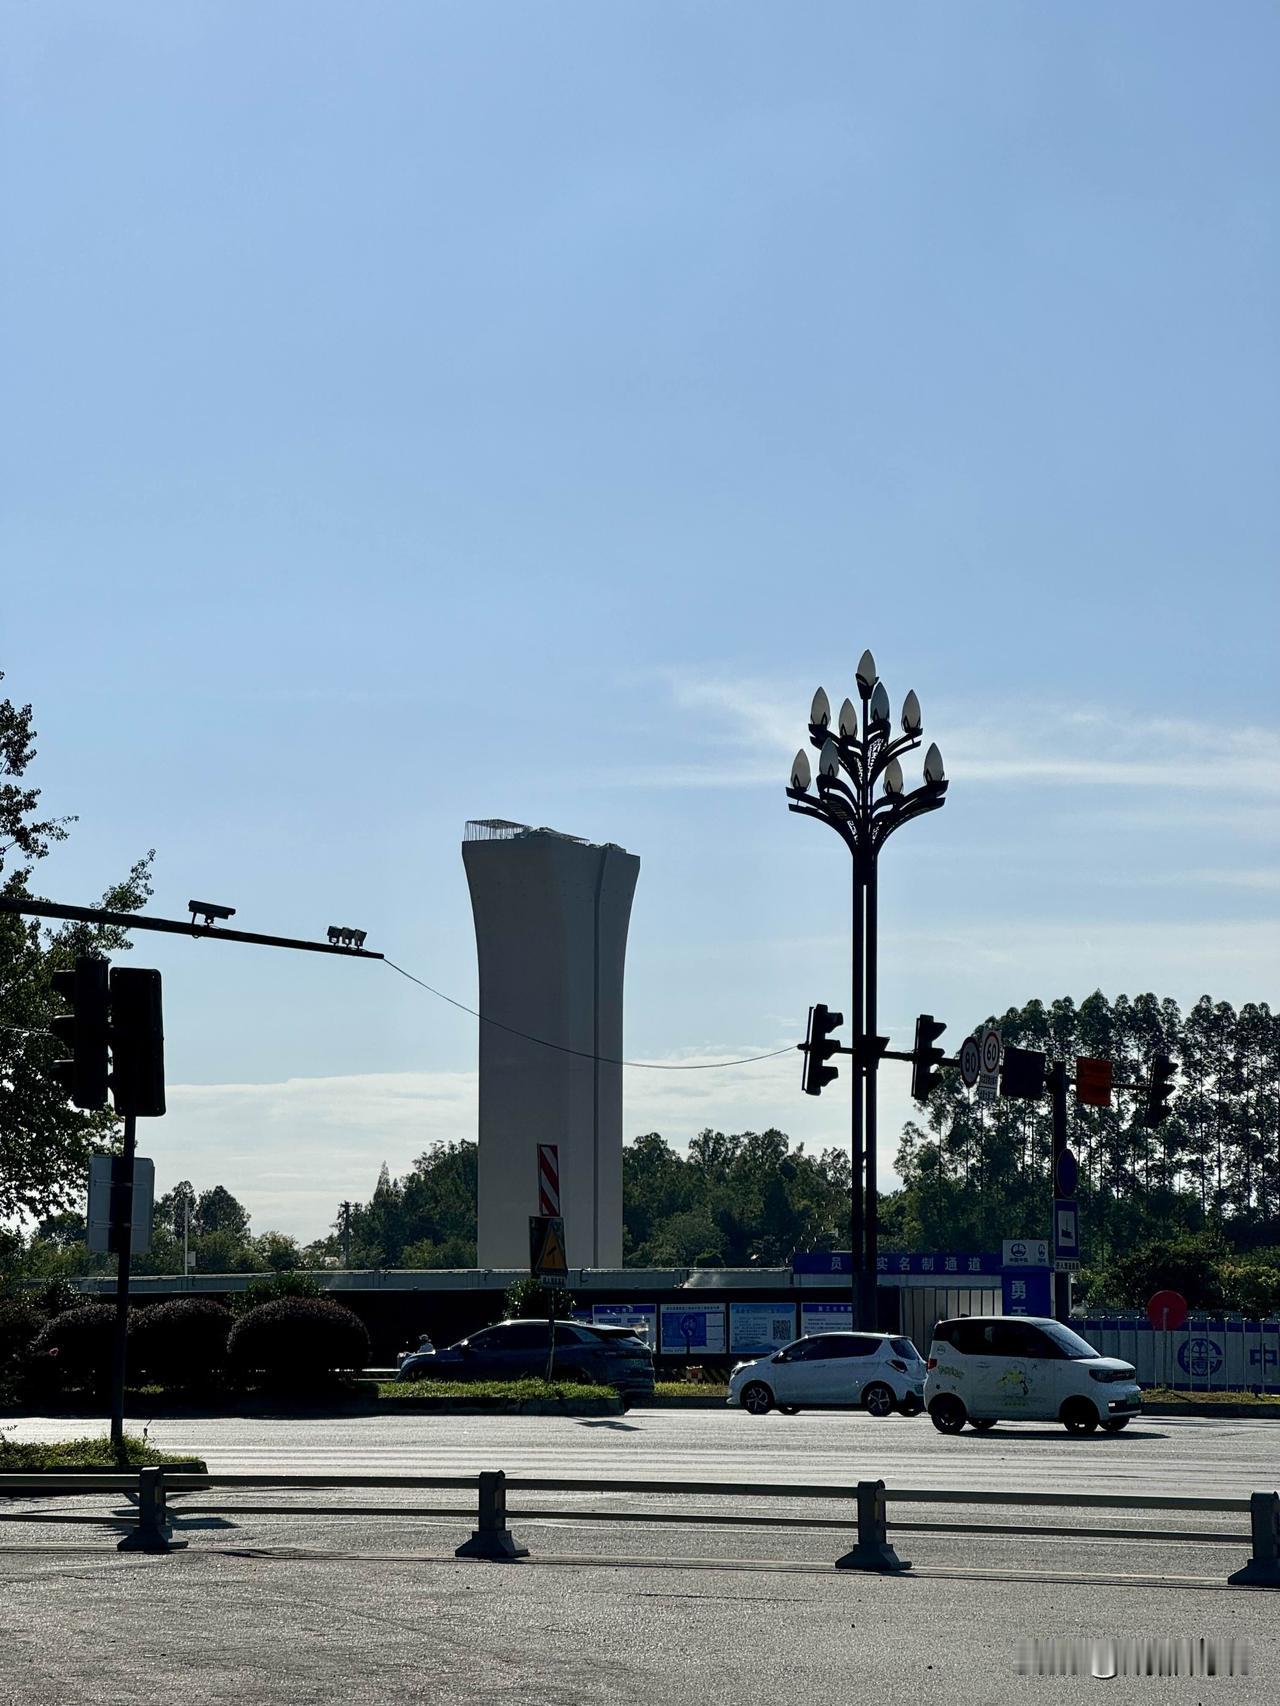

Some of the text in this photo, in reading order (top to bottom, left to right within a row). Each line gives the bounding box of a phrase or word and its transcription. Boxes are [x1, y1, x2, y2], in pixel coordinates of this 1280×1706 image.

[965, 1051, 976, 1073] 80
[986, 1043, 997, 1061] 60
[830, 1256, 982, 1272] 员实名制通道
[1249, 1342, 1278, 1376] 中
